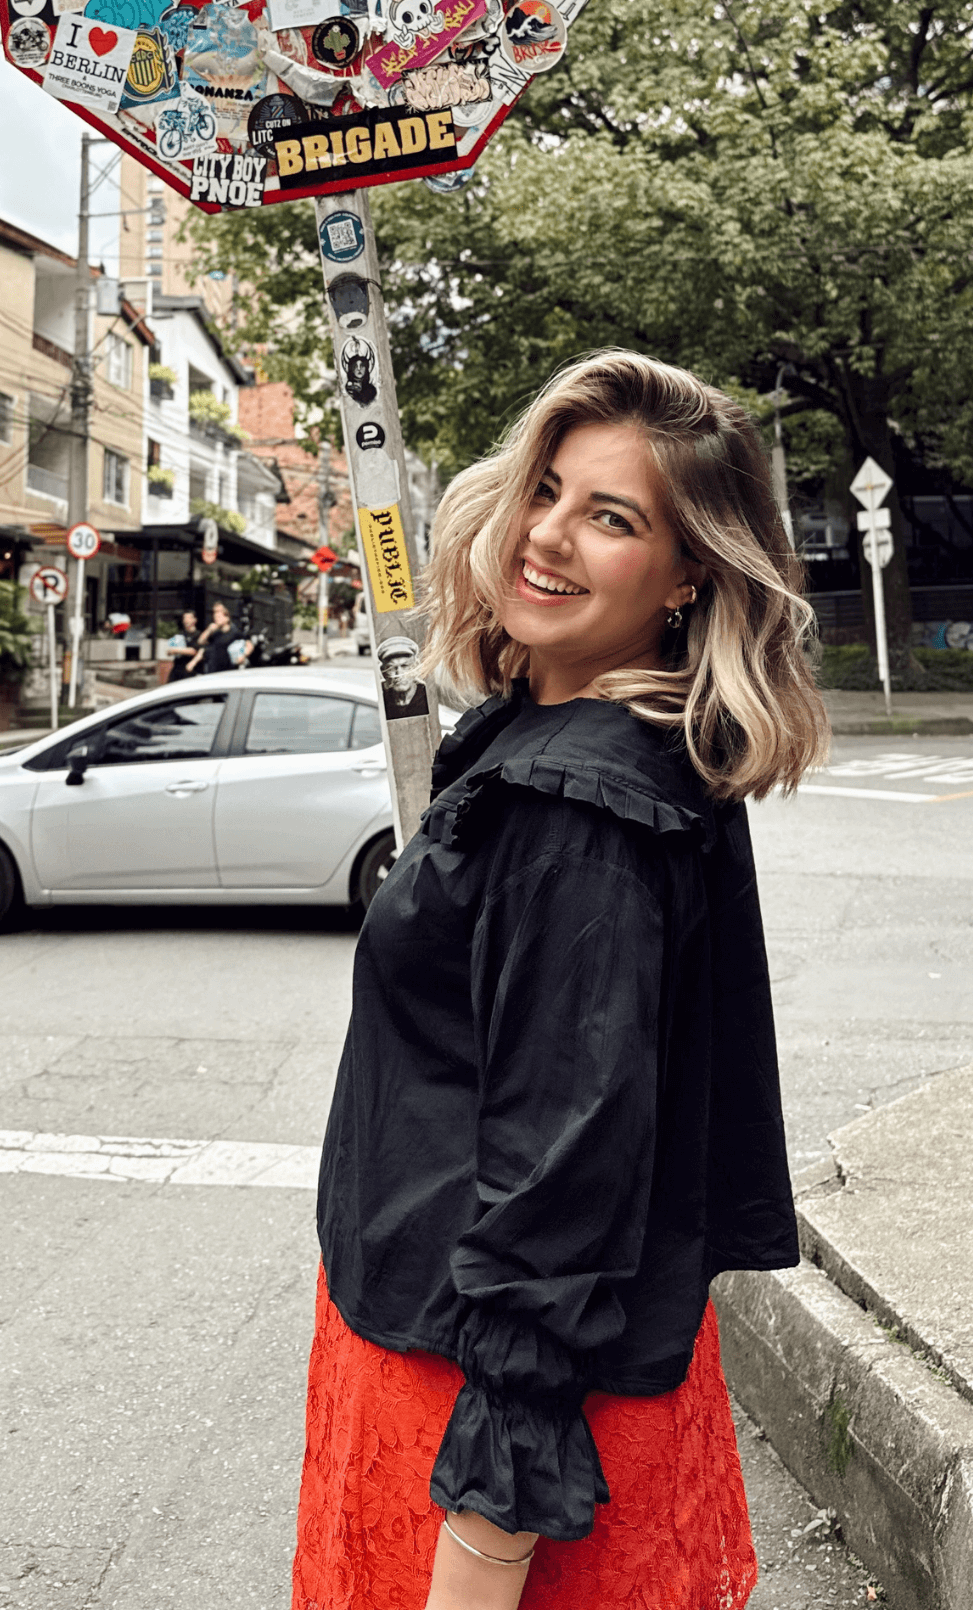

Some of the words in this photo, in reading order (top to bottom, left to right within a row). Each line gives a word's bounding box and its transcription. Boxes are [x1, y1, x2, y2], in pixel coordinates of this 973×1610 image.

[66, 23, 83, 48] I
[50, 49, 126, 84] BERLIN
[49, 73, 70, 85] THREE
[71, 79, 96, 92] BOONS
[97, 86, 117, 98] YOGA
[190, 83, 254, 101] ONANZA
[265, 119, 281, 129] CUTZ
[281, 118, 292, 127] ON
[275, 110, 455, 177] BRIGADE
[193, 153, 232, 179] CITY
[232, 155, 267, 183] BOY
[190, 175, 264, 208] PNOE
[73, 532, 95, 549] 30
[370, 511, 408, 605] PUBLIC
[42, 575, 58, 598] P
